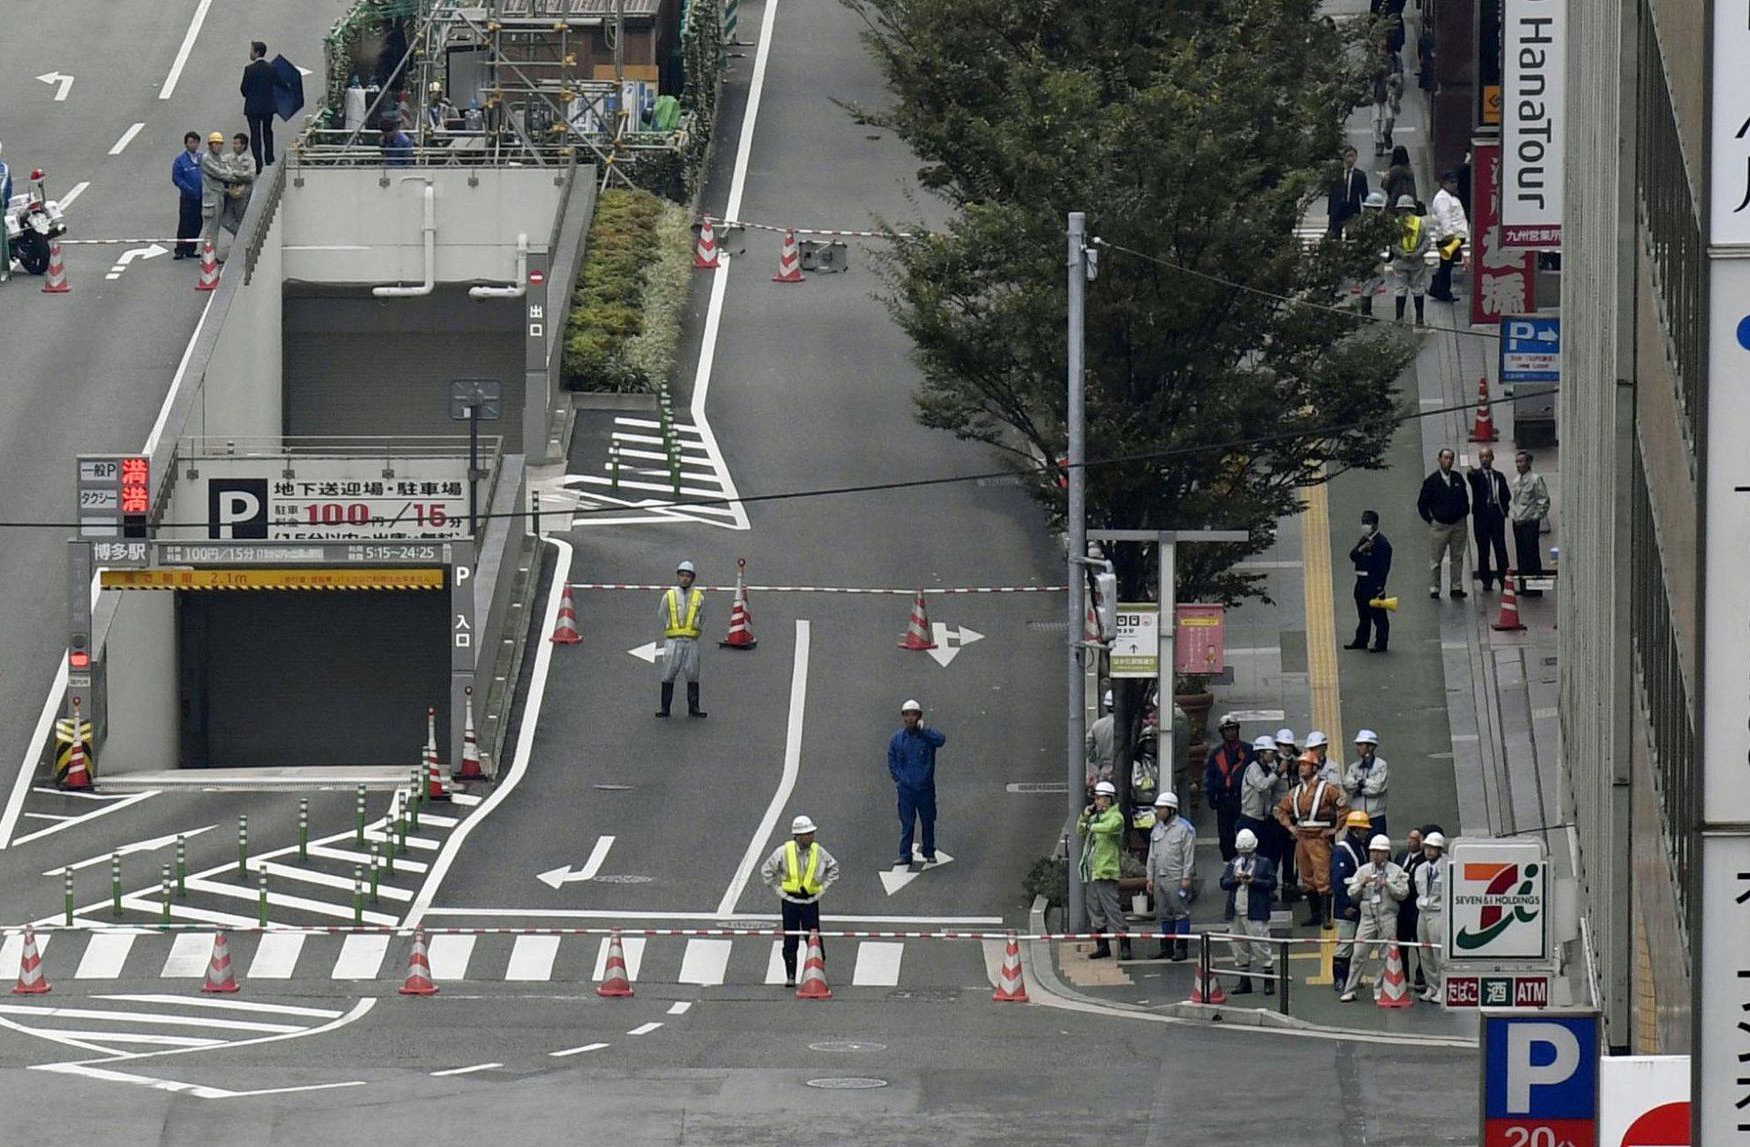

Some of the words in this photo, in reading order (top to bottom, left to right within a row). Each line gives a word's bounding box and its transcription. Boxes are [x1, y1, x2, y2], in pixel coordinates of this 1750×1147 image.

[1518, 17, 1553, 210] HanaTour
[530, 304, 543, 337] 出口
[1509, 322, 1535, 350] P
[82, 464, 116, 477] 一般P
[122, 459, 147, 484] 満
[82, 492, 116, 504] タクシー
[122, 487, 147, 512] 満
[274, 481, 462, 497] 地下送迎場・駐車場
[219, 490, 260, 539] P
[94, 542, 146, 561] 博多駅
[211, 572, 248, 583] 2.1m
[456, 567, 470, 586] P
[455, 614, 470, 647] 入口
[1495, 895, 1540, 905] HOLDINGS
[1447, 983, 1478, 1001] たばこ
[1487, 984, 1507, 1001] 酒
[1517, 981, 1546, 1001] ATM
[1507, 1022, 1581, 1114] P
